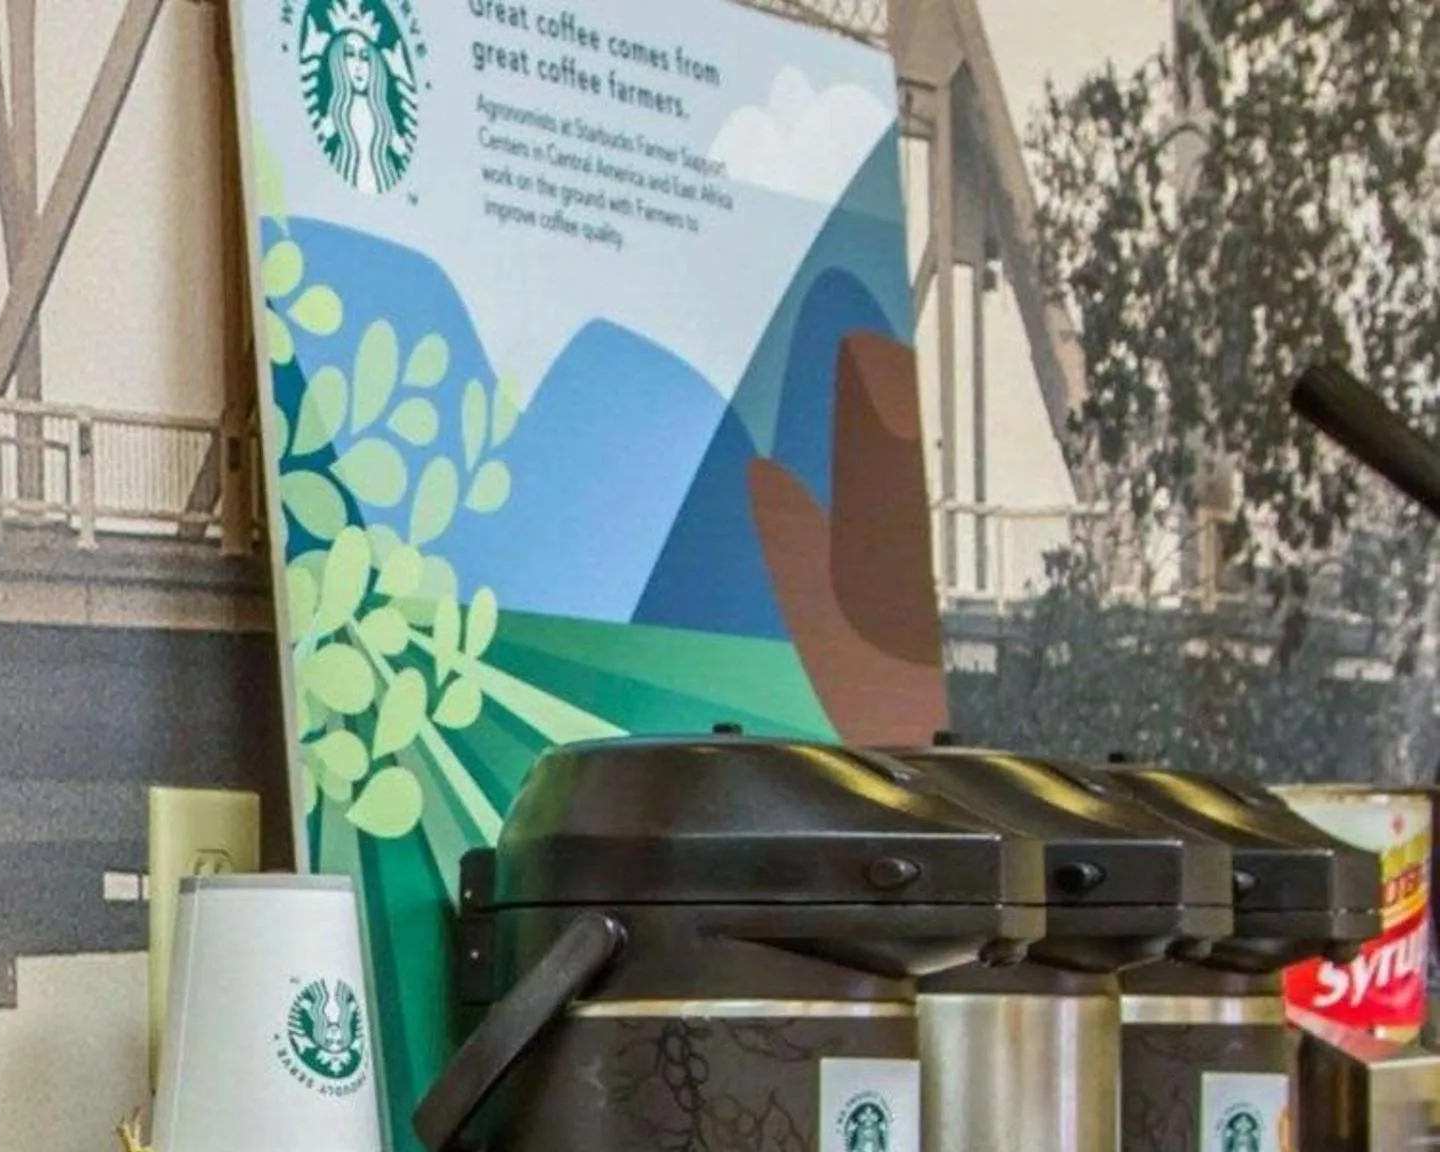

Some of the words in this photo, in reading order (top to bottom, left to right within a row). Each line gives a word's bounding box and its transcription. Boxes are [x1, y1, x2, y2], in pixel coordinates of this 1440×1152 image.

[536, 10, 600, 49] coffee
[609, 36, 669, 71] comes
[674, 46, 721, 88] from
[473, 40, 530, 75] great
[537, 55, 601, 94] coffee
[609, 69, 690, 118] farmers.
[478, 125, 530, 158] Centers
[574, 118, 635, 151] Starbucks
